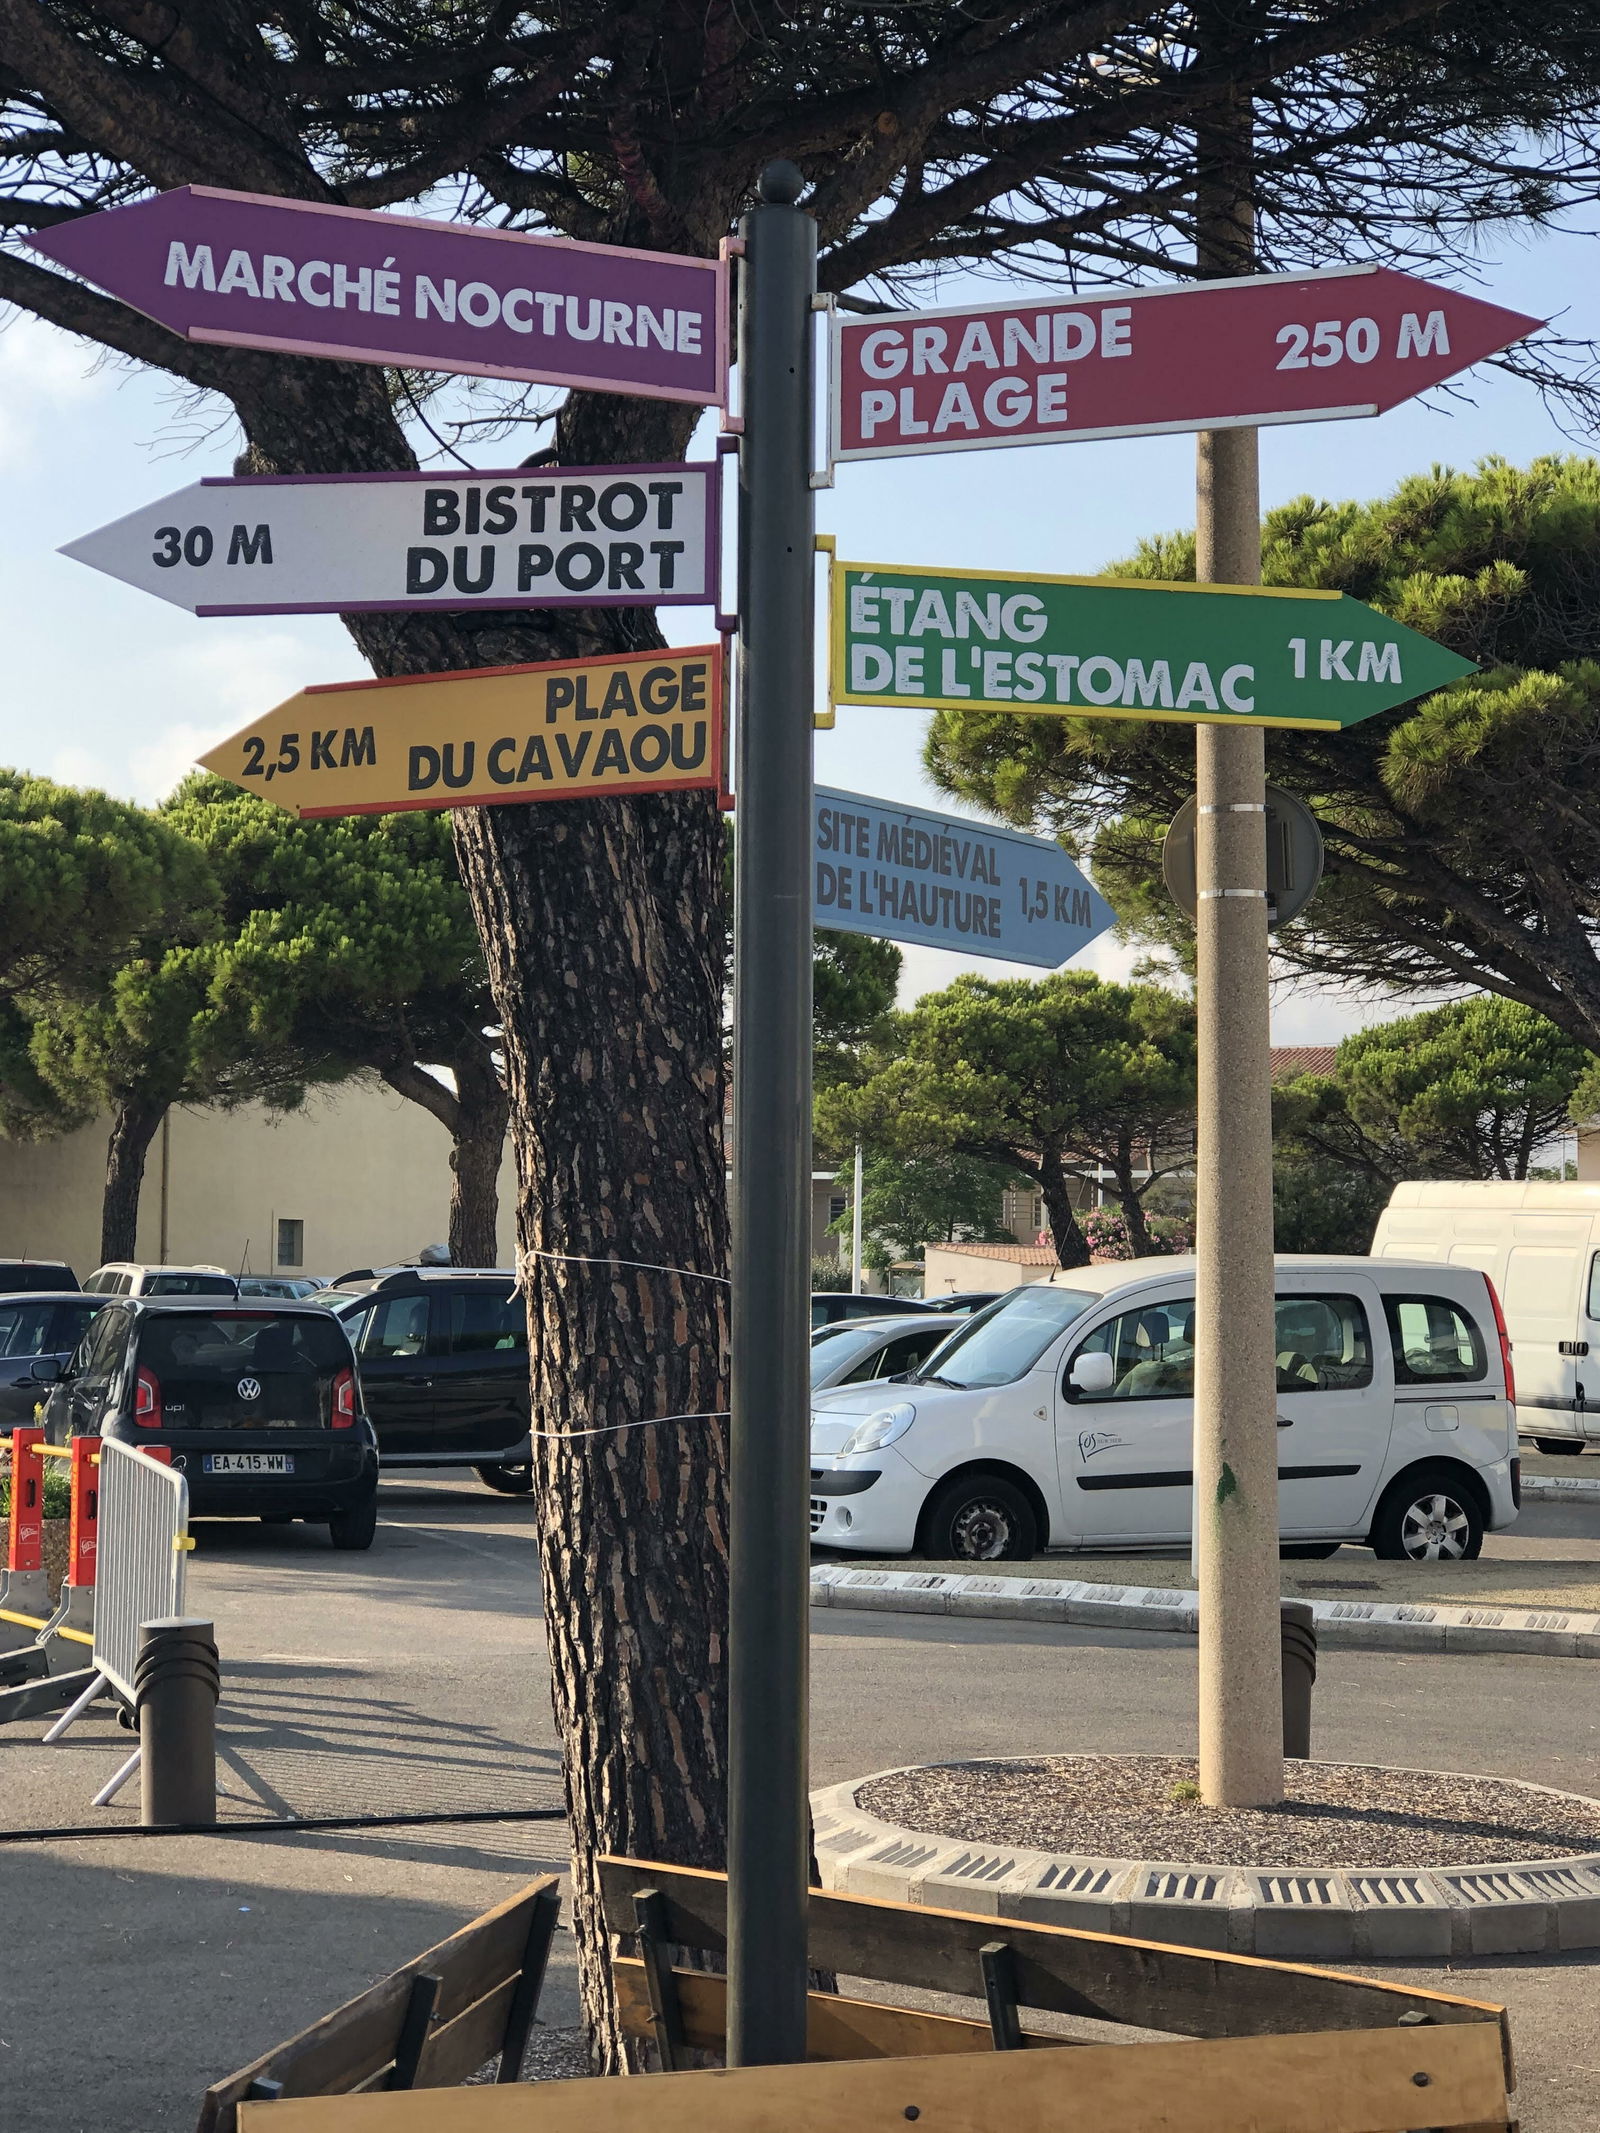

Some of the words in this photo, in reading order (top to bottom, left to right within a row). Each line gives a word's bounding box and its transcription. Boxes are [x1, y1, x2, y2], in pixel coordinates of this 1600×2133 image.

[164, 240, 401, 316] MARCHÉ
[416, 274, 702, 355] NOCTURNE
[860, 306, 1133, 380] GRANDE
[1275, 318, 1380, 370] 250
[1396, 311, 1451, 359] M
[861, 373, 1068, 440] PLAGE
[424, 482, 684, 536] BISTROT
[152, 524, 214, 567] 30
[227, 524, 274, 566] M
[406, 545, 496, 595] DU
[517, 541, 685, 593] PORT
[850, 572, 1048, 644] ÉTANG
[851, 644, 925, 695] DE
[942, 646, 1255, 713] L'ESTOMAC
[1288, 638, 1306, 679] 1
[1320, 639, 1403, 684] KM
[546, 664, 707, 724] PLAGE
[242, 733, 301, 782] 2,5
[311, 726, 377, 771] KM
[408, 737, 476, 791] DU
[487, 720, 707, 785] CAVAOU
[817, 808, 869, 858] SITE
[877, 815, 1000, 886] MÉDIÉVAL
[817, 862, 852, 910] DE
[860, 870, 1001, 938] L'HAUTURE
[1019, 877, 1049, 923] 1,5
[1055, 884, 1092, 928] KM
[165, 1404, 185, 1412] up!
[213, 1455, 283, 1470] EA-415-WW
